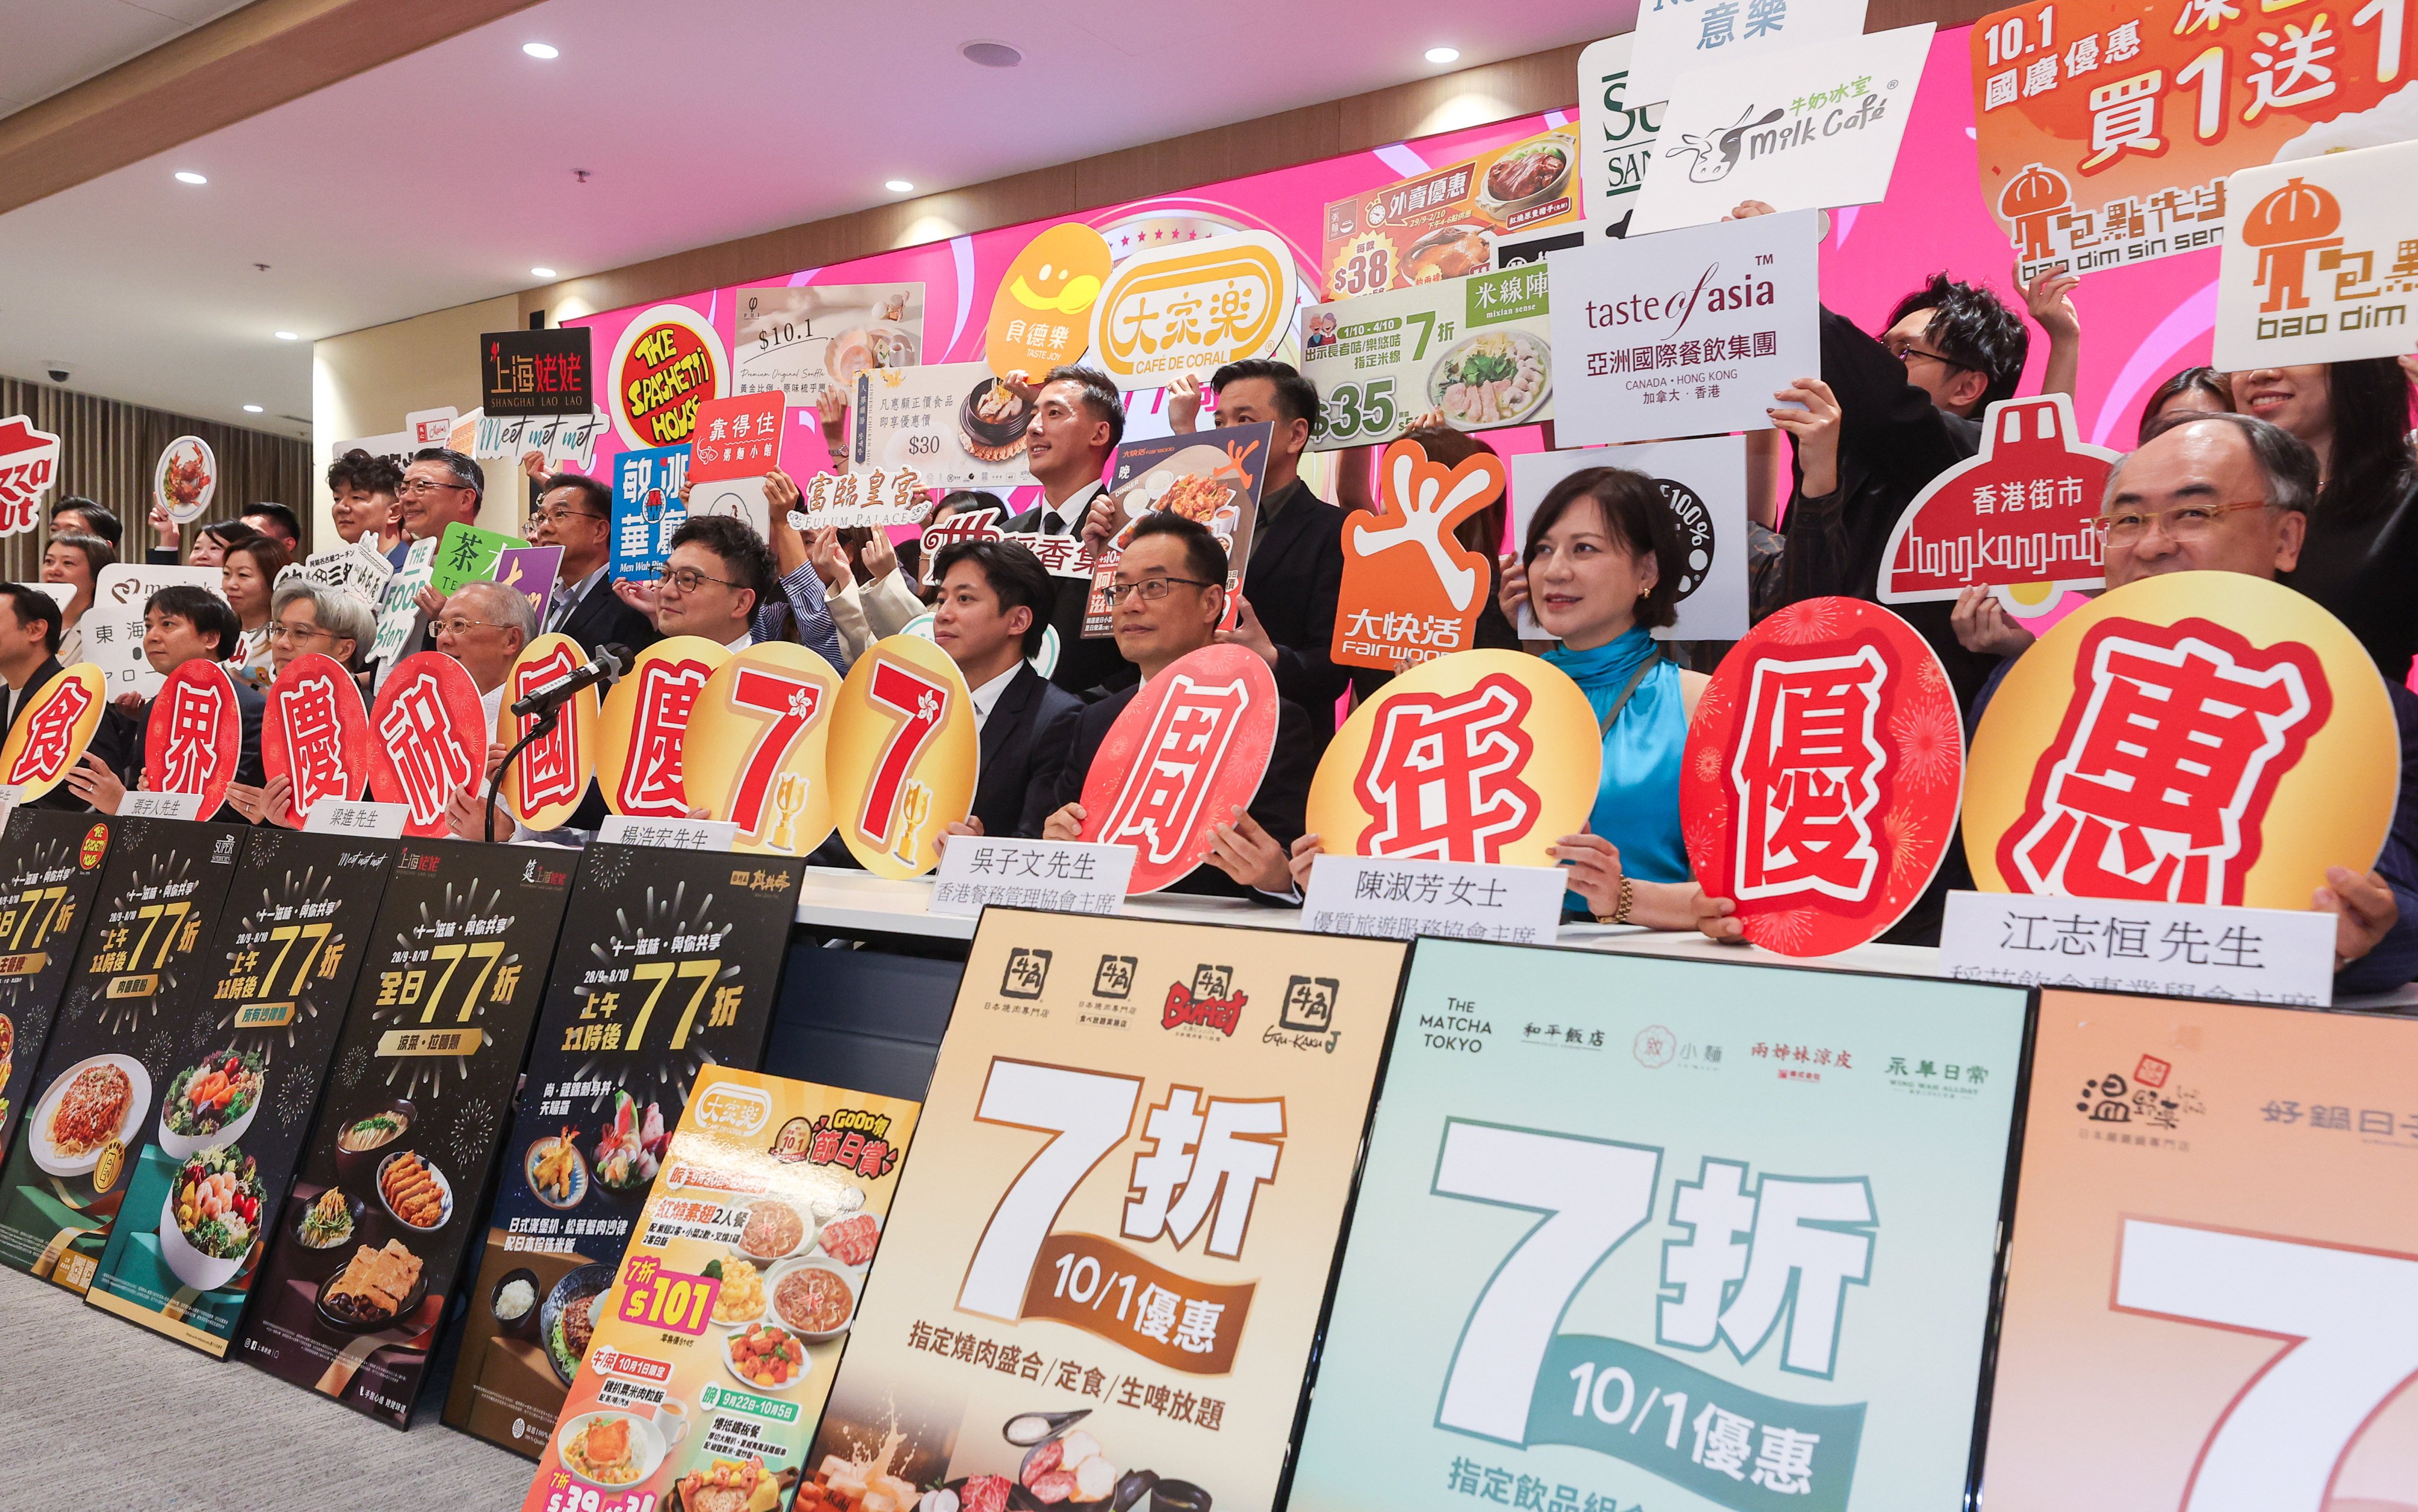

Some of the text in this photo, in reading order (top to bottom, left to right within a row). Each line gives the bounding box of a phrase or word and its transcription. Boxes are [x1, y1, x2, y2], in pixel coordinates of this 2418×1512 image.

[1696, 0, 1787, 51] 意樂
[1985, 5, 2052, 66] 10.1
[1984, 19, 2142, 112] 國慶優惠
[1789, 75, 1872, 117] 牛奶冰室
[1388, 171, 1469, 217] 外賣優惠
[1409, 209, 1447, 228] 29/9-2/10
[1428, 210, 1473, 230] 下午4-6點供應
[1356, 240, 1375, 254] 每款
[2077, 249, 2120, 270] dim
[2128, 239, 2166, 260] sin
[1334, 247, 1389, 293] $38
[1475, 272, 1548, 310] 米線陣
[1585, 262, 1774, 341] taste of asia
[1486, 303, 1536, 319] mixian sense
[2257, 304, 2406, 341] bao dim
[758, 318, 813, 351] $10.1
[1005, 319, 1069, 350] 食德樂
[1343, 319, 1395, 338] 1/10 4/10
[635, 328, 677, 368] THE
[1026, 349, 1062, 361] TASTE JOY
[1135, 349, 1231, 374] CAFÉ DE CORAL
[1305, 334, 1401, 362] 出示長者咭/樂悠咭
[1354, 350, 1401, 370] 指定米線
[1587, 331, 1777, 377] 亞洲國際餐飲集團
[491, 352, 582, 394] 上海姥姥
[772, 367, 799, 382] Original
[1626, 369, 1738, 391] CANADA HONG KONG
[491, 396, 582, 408] SHANGHAI LAO LAO
[879, 394, 954, 412] 凡惠顧正價食品
[1309, 376, 1397, 443] $35
[1643, 384, 1721, 405] 加拿大 香港
[709, 410, 775, 442] 靠得住
[879, 413, 931, 429] 即享優惠價
[479, 414, 604, 461] Meet met met
[723, 444, 774, 462] 粥麵小館
[909, 435, 940, 455] $30
[1118, 464, 1130, 480] 晚
[808, 467, 918, 512] 富臨皇宮
[1115, 479, 1139, 498] DINNER
[1973, 475, 2084, 516] 香港街市
[410, 546, 428, 566] THE
[1343, 609, 1462, 647] 大快活
[11, 680, 91, 783] 食
[162, 680, 222, 793] 界
[280, 674, 350, 817] 慶
[515, 649, 579, 811] 國
[380, 672, 472, 827] 祝
[727, 667, 825, 838] 7
[860, 658, 949, 844] 7
[1098, 674, 1250, 864] 周
[1366, 684, 1528, 863] 年
[1731, 644, 1889, 903] 優
[2012, 636, 2312, 906] 惠
[131, 798, 181, 817] 張宇人先生
[329, 807, 378, 828] 梁進先生
[214, 841, 236, 855] SUPER
[620, 824, 709, 850] 楊浩宏先生
[397, 852, 441, 872] 上海姥姥
[970, 847, 1097, 880] 吳子文先生
[937, 882, 1116, 915] 香港餐務管理協會主席
[1354, 870, 1507, 908] 陳淑芳女士
[103, 928, 129, 951] 上午
[2000, 910, 2266, 969] 江志恒先生
[89, 951, 128, 973] 11時後
[229, 951, 260, 974] 上午
[391, 949, 429, 964] 28/9-8/10
[213, 976, 259, 1000] 11時後
[375, 969, 428, 1007] 全日
[583, 968, 629, 984] 28/9-8/10
[579, 991, 621, 1020] 上午
[1447, 997, 1476, 1014] THE
[560, 1023, 622, 1052] 11時後
[1419, 1014, 1493, 1036] MATCHA
[1523, 1021, 1606, 1048] 和平飯店
[1424, 1034, 1483, 1053] TOKYO
[811, 1129, 887, 1178] 節日賞
[954, 1055, 1289, 1326] 7折
[627, 1259, 656, 1285] 7折
[1430, 1116, 1881, 1451] 7折
[625, 1276, 711, 1330] $101
[1054, 1252, 1226, 1355] 10/1優惠
[1568, 1361, 1821, 1495] 10/1優惠
